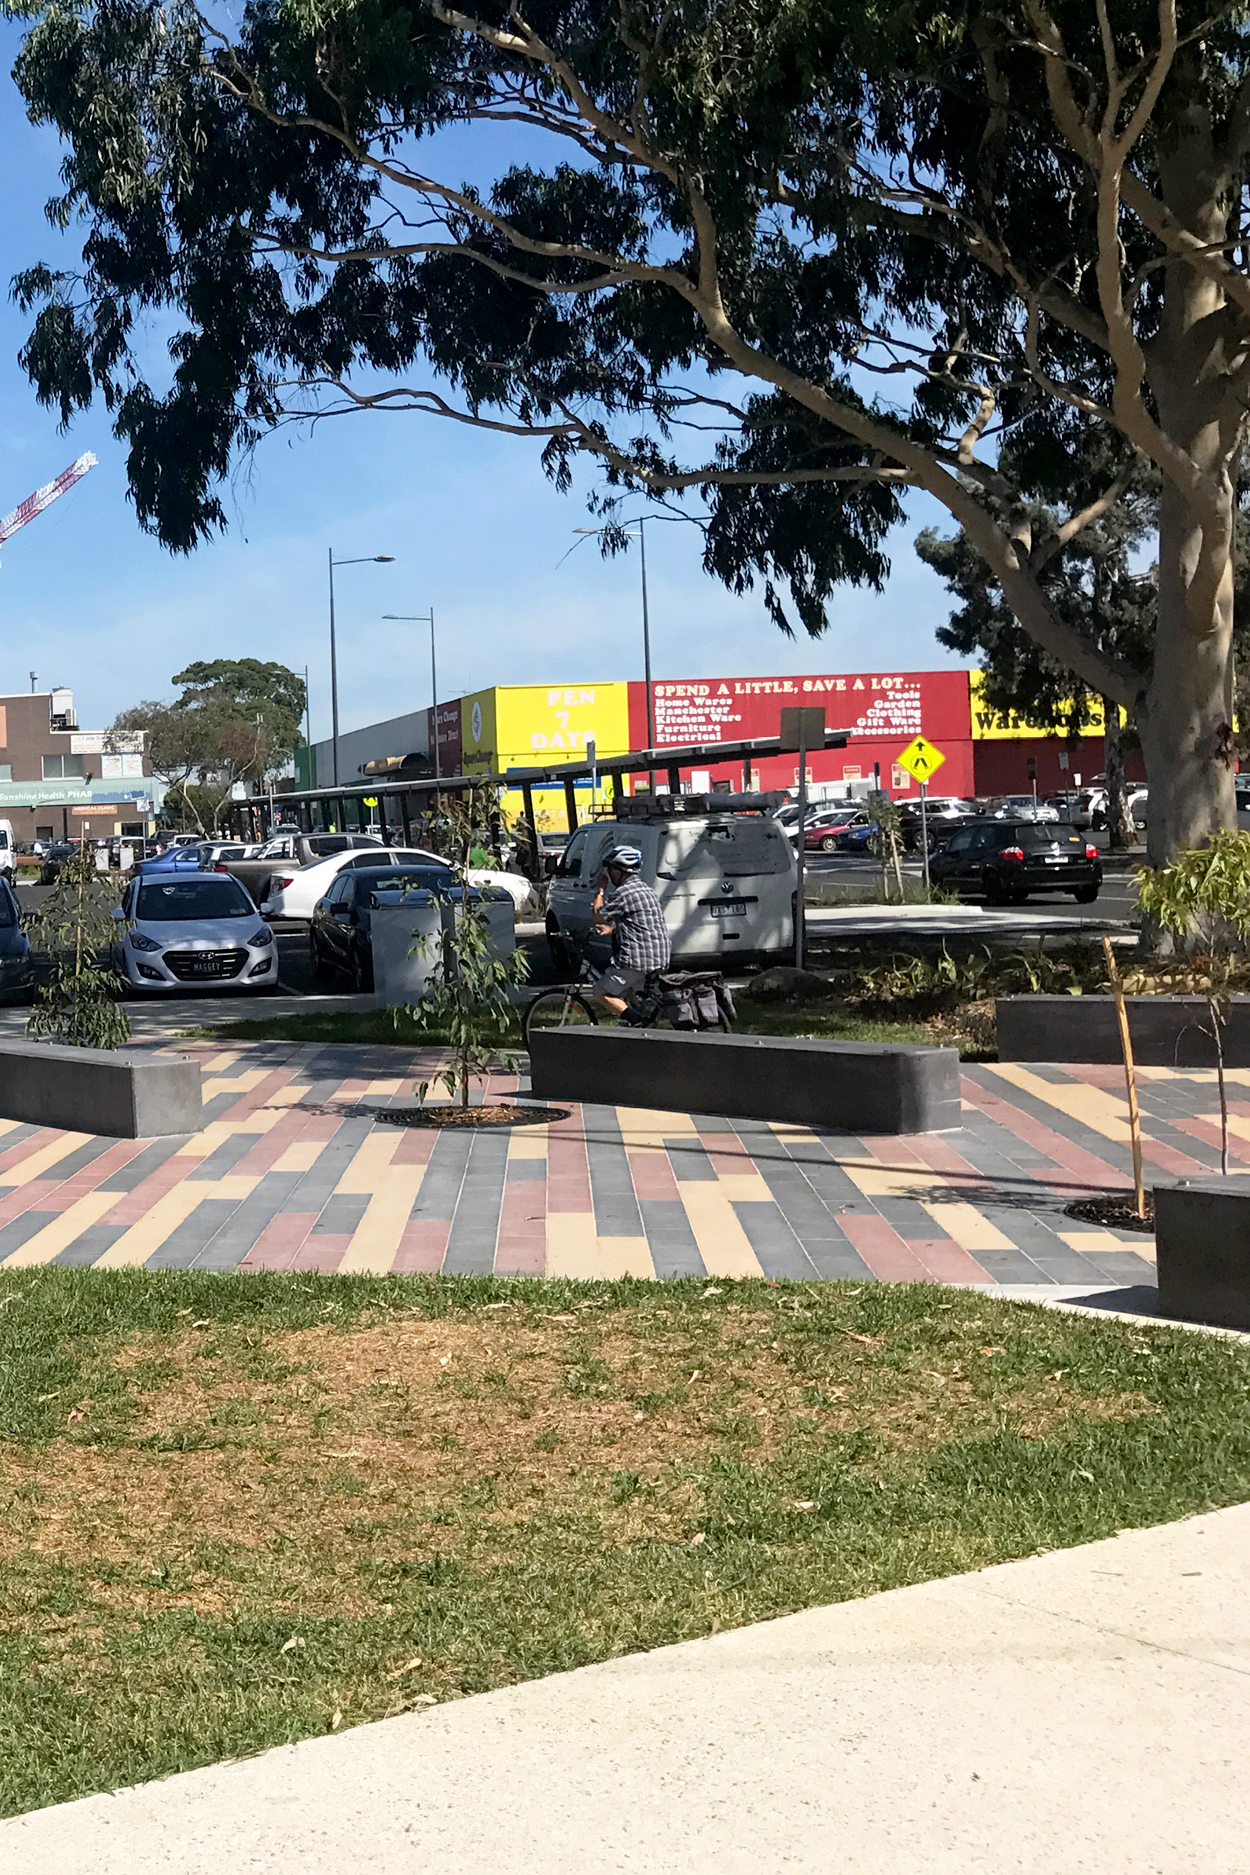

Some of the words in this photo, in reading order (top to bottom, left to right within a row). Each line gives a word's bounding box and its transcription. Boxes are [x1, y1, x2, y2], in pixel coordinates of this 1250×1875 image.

[654, 685, 710, 697] SPEND
[716, 683, 730, 695] A
[734, 681, 799, 694] LITTLE,
[802, 679, 847, 692] SAVE
[852, 678, 865, 690] A
[870, 677, 921, 690] LOT...
[886, 690, 921, 700] Tools
[655, 698, 690, 707] Home
[693, 697, 733, 706] Wares
[873, 699, 921, 709] Garden
[655, 706, 730, 716] Manchester
[866, 708, 922, 718] Clothing
[555, 711, 570, 729] 7
[655, 715, 706, 724] Kitchen
[710, 714, 742, 722] Ware
[856, 717, 885, 727] Gift
[889, 716, 922, 726] Ware
[656, 724, 721, 733] Furniture
[530, 731, 597, 750] DAYS
[656, 732, 722, 742] Electrical
[38, 790, 64, 800] Health
